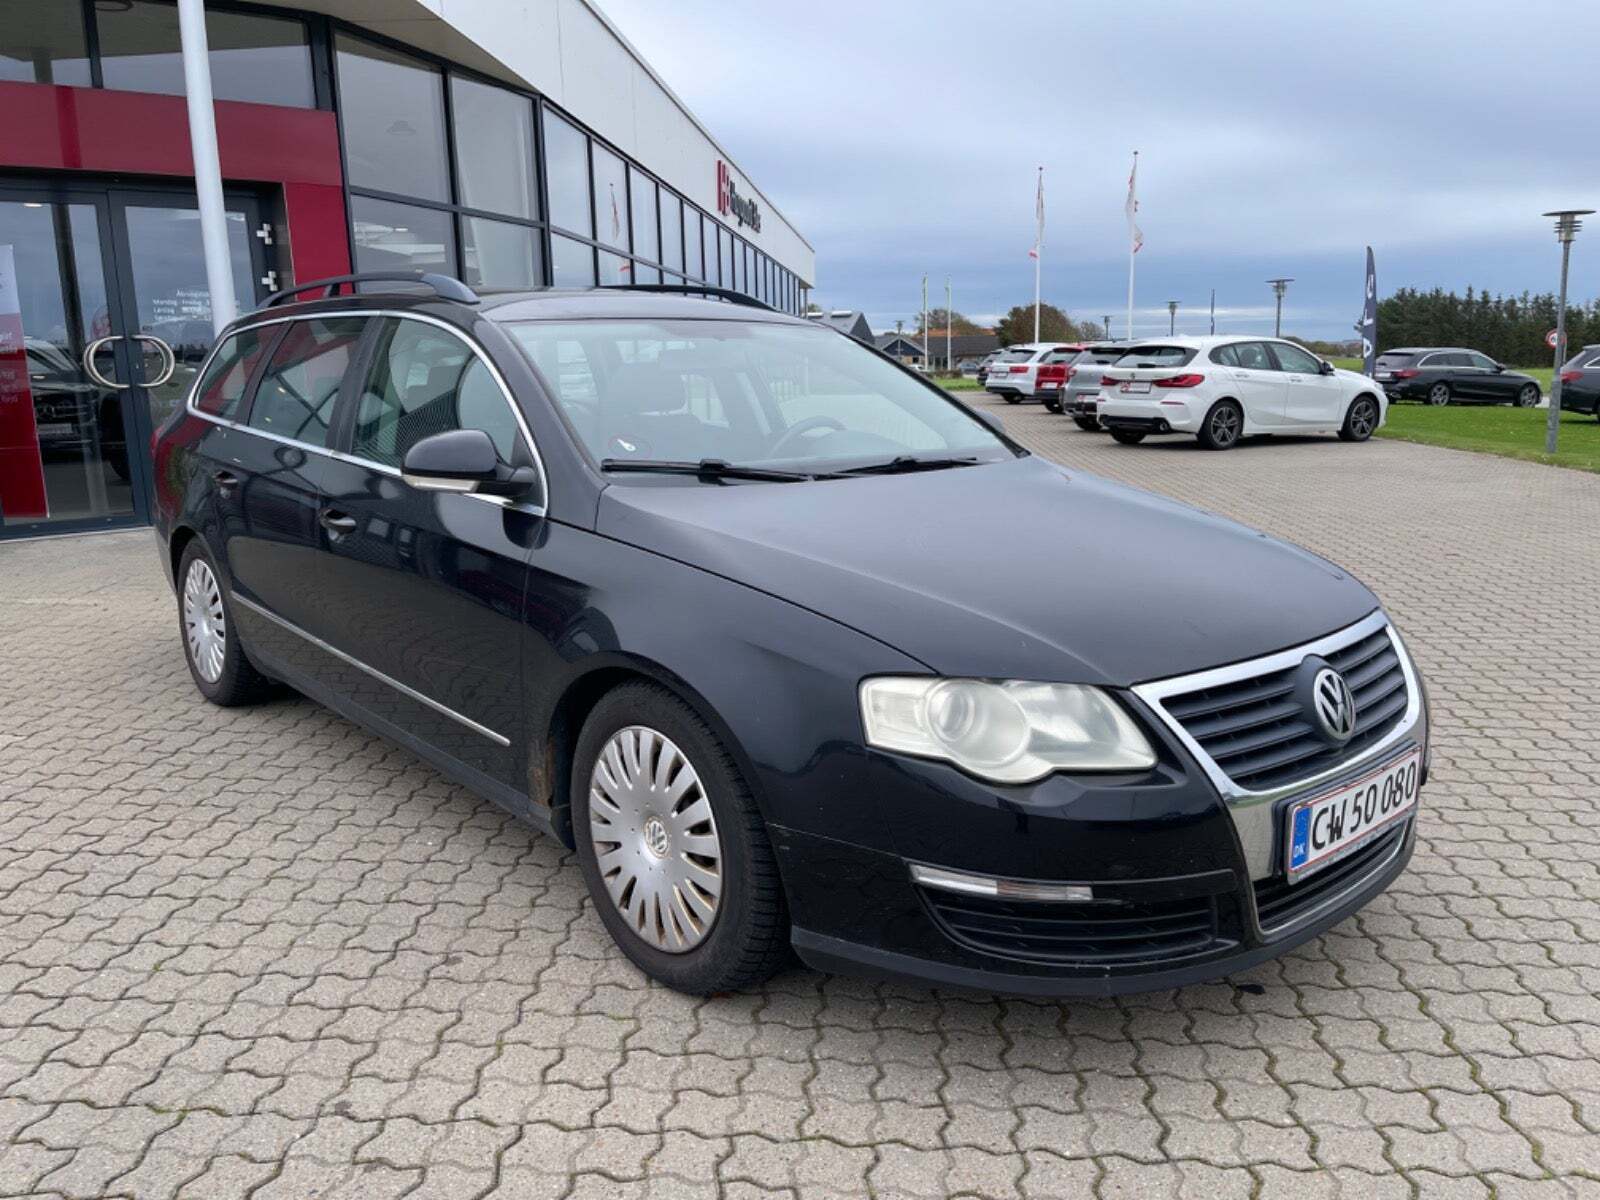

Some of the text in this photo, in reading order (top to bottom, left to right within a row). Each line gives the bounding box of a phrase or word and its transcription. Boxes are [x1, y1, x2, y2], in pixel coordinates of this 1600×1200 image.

[1312, 760, 1416, 850] CW 50 080
[1293, 842, 1306, 858] DK
